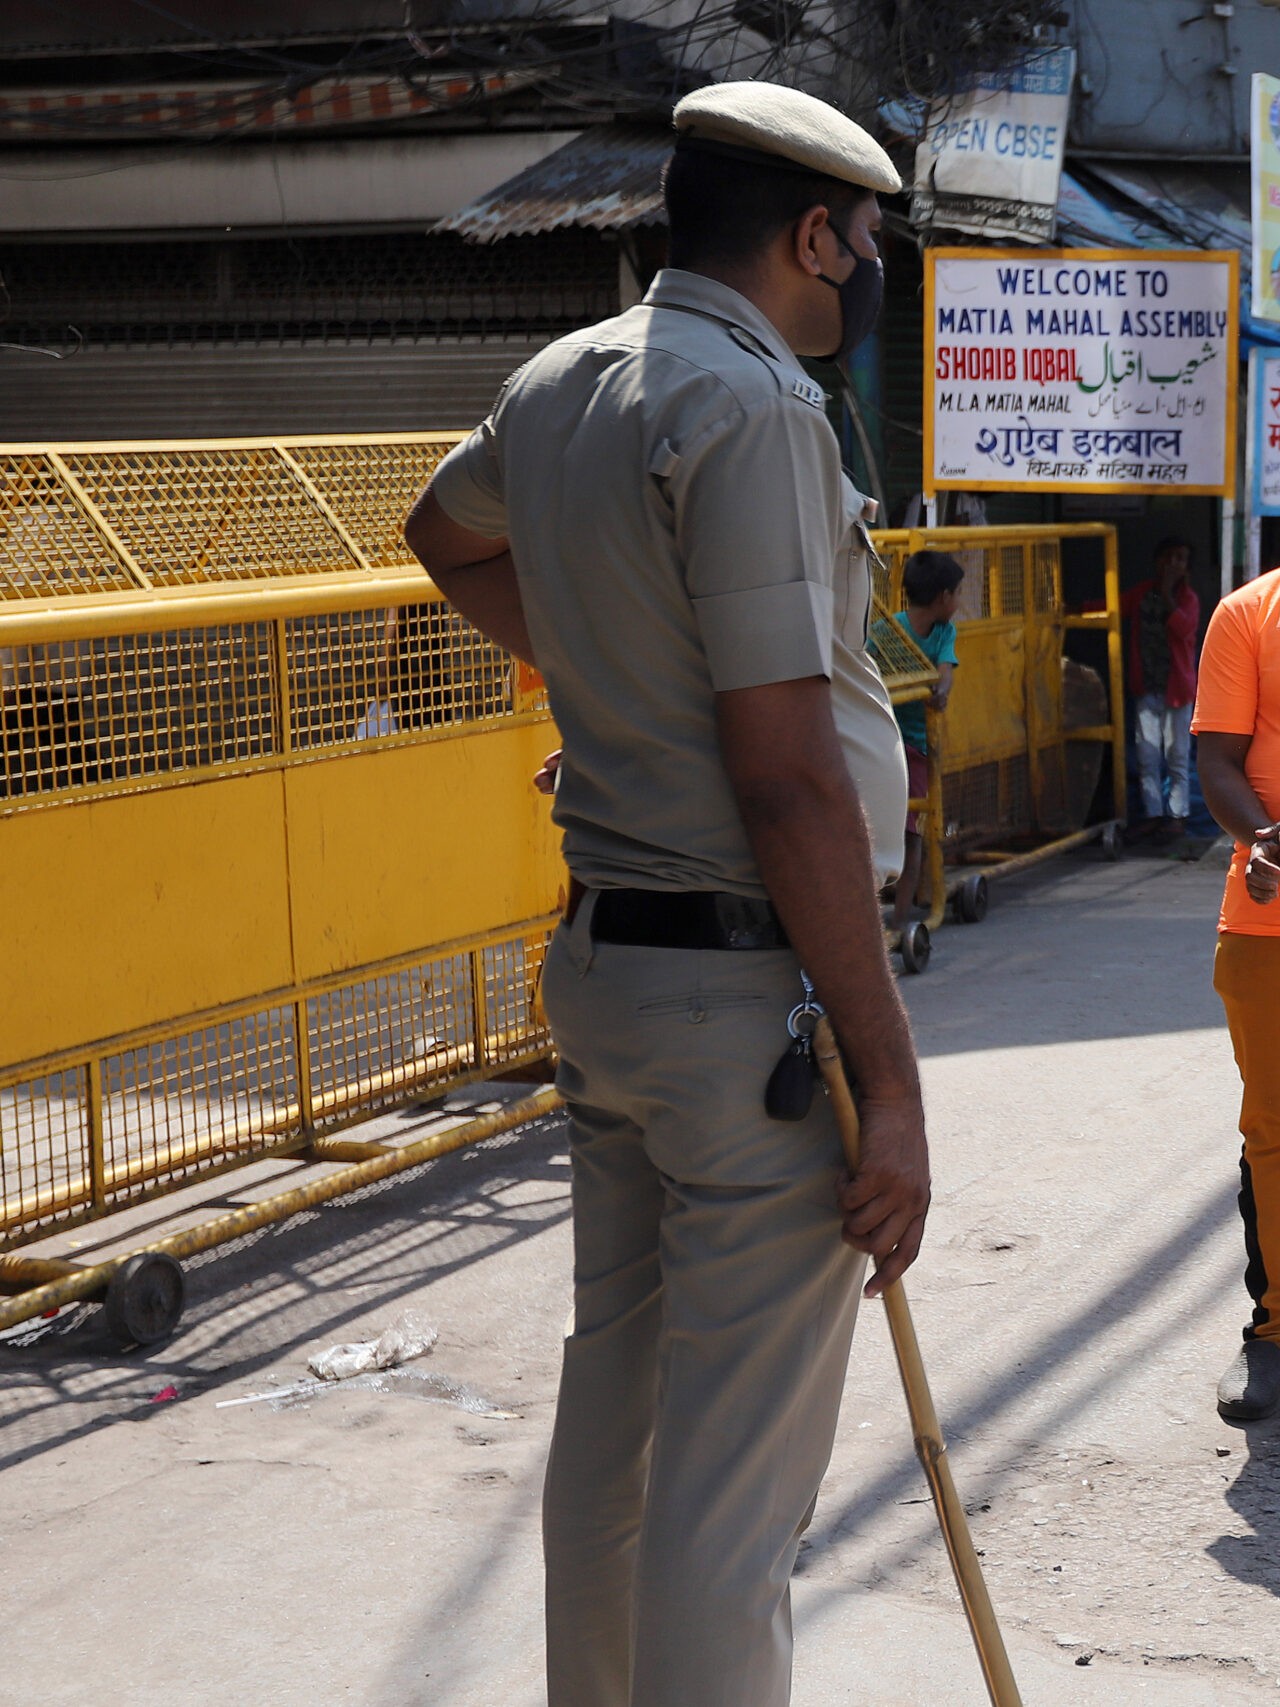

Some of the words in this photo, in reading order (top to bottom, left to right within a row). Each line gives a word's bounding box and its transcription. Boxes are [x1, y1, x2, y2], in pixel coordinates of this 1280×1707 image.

[931, 119, 988, 154] OPEN
[995, 121, 1057, 160] CBSE
[997, 267, 1127, 297] WELCOME
[1136, 269, 1168, 298] TO
[937, 307, 1014, 335] MATIA
[1026, 308, 1110, 336] MAHAL
[1119, 309, 1227, 338] ASSEMBLY
[936, 346, 1017, 381] SHOAIB
[1023, 347, 1083, 386] IQBAL
[985, 392, 1023, 412] MATIA
[1027, 394, 1071, 413] MAHAL
